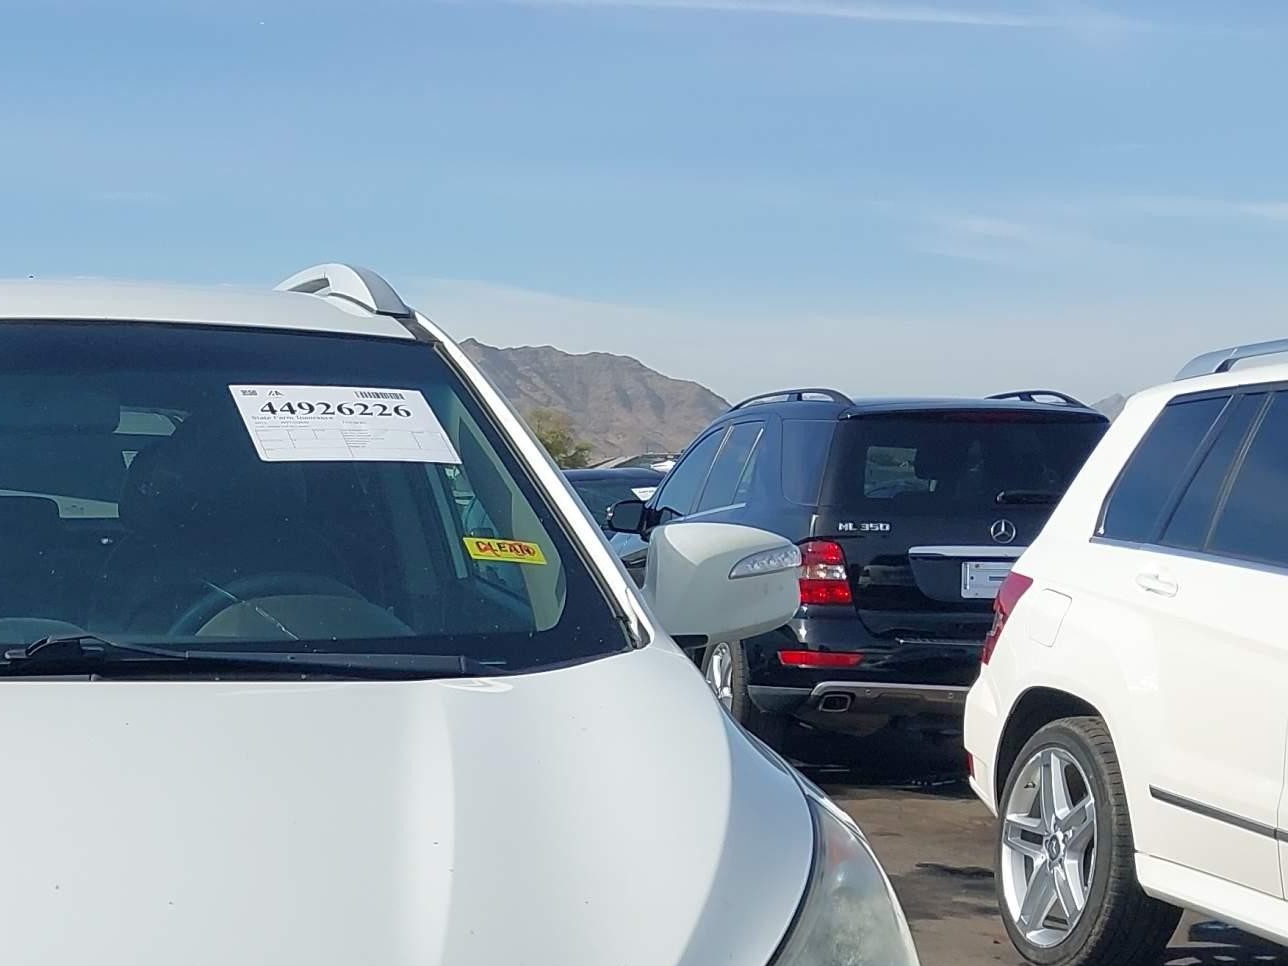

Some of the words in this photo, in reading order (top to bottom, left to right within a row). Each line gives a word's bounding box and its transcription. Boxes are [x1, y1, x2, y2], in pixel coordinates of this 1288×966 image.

[260, 401, 411, 417] 44926226
[838, 522, 857, 531] ML
[860, 522, 890, 531] 350
